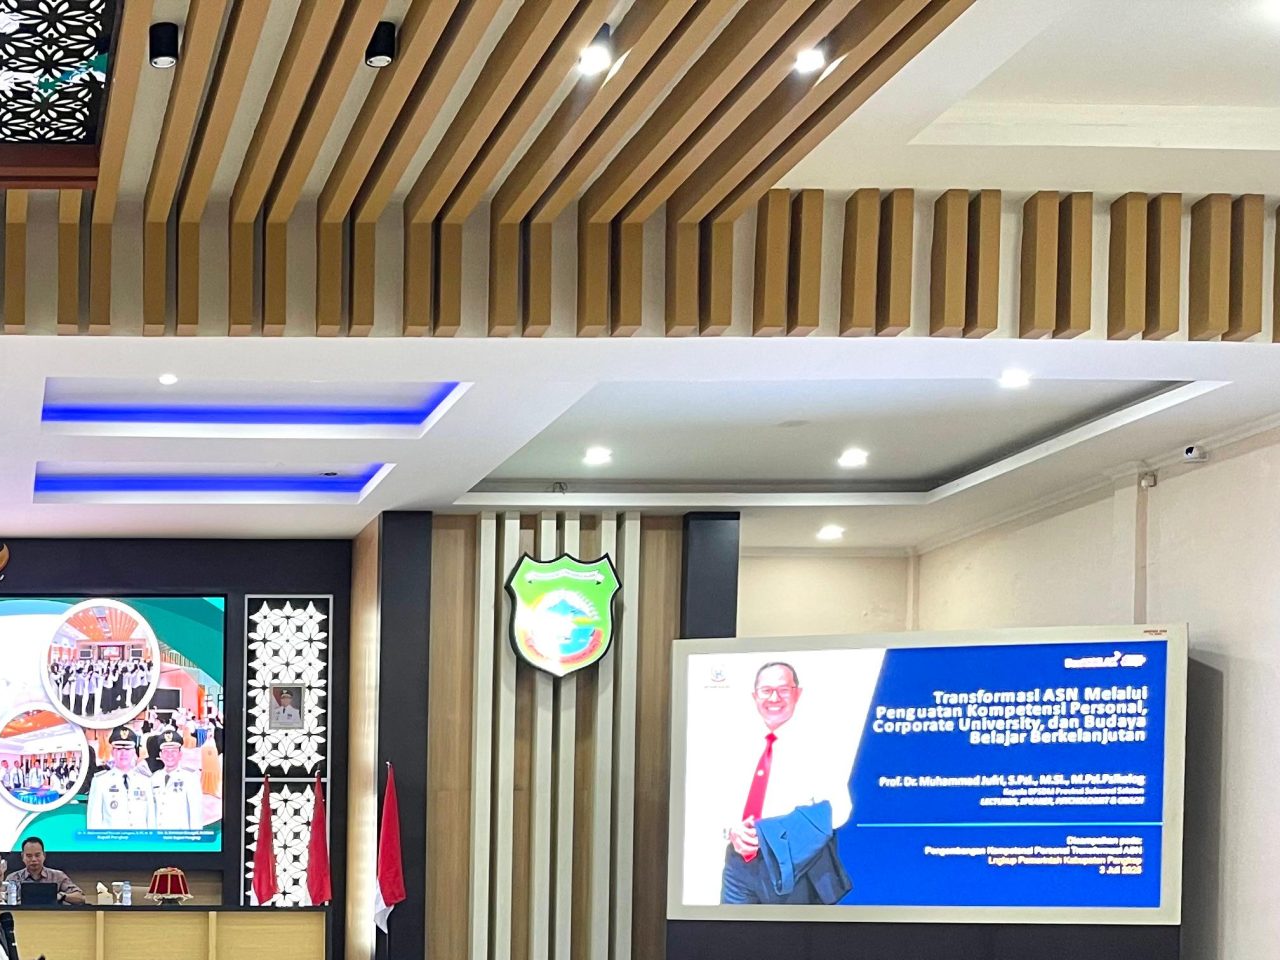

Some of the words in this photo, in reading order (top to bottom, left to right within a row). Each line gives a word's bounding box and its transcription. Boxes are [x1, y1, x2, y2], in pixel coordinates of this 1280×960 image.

[933, 688, 1040, 704] Transformasi
[1043, 687, 1078, 702] ASN
[1084, 686, 1148, 701] Melalui
[876, 706, 962, 721] Penguatan
[967, 701, 1066, 719] Kompetensi
[1070, 700, 1148, 716] Personal,
[873, 718, 954, 735] Corporate
[958, 715, 1044, 732] University,
[1048, 715, 1079, 730] dan
[1084, 714, 1146, 732] Budaya
[970, 730, 1027, 747] Belajar
[1030, 728, 1146, 745] Berkelanjutan
[879, 775, 902, 787] Prof.
[904, 776, 917, 787] Dr.
[919, 775, 980, 787] Muhammad
